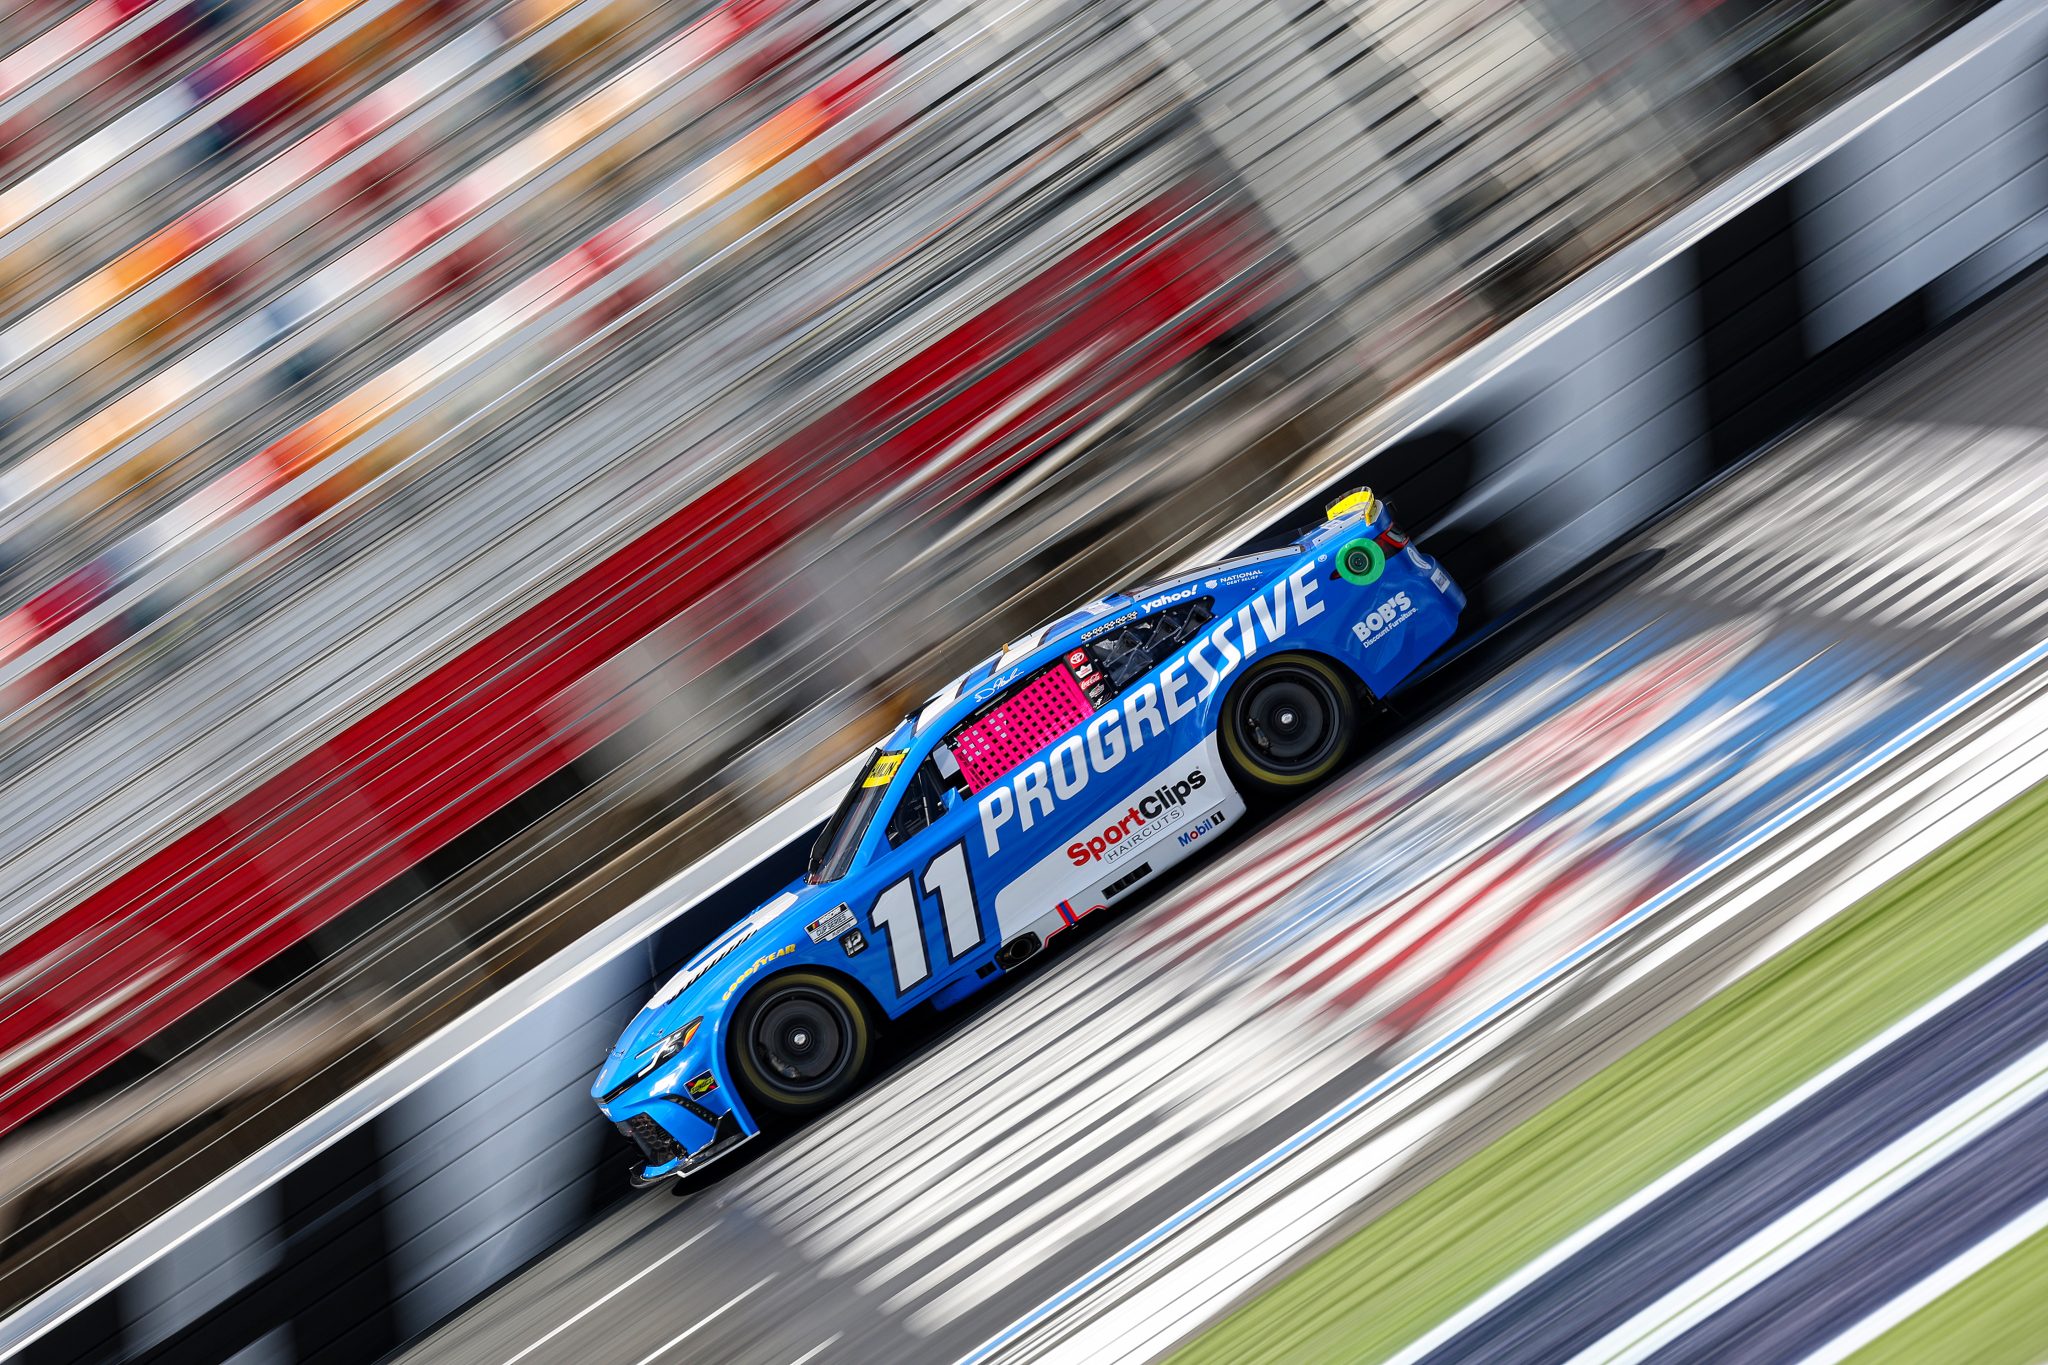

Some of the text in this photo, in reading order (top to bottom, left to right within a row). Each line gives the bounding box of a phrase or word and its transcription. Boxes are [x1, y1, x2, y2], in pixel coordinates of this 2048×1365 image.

[1141, 584, 1198, 613] yahoo!
[1220, 569, 1263, 583] NATIONAL
[1352, 591, 1411, 642] BOB'S
[1363, 626, 1390, 649] Discount
[978, 560, 1326, 858] PROGRESSIVE
[1066, 769, 1207, 867] SportClips
[1107, 809, 1181, 861] HAIRCUTS
[1178, 812, 1224, 847] Mobil 1
[844, 930, 865, 956] 12
[869, 840, 983, 996] 11
[722, 943, 797, 1001] GOODYEAR
